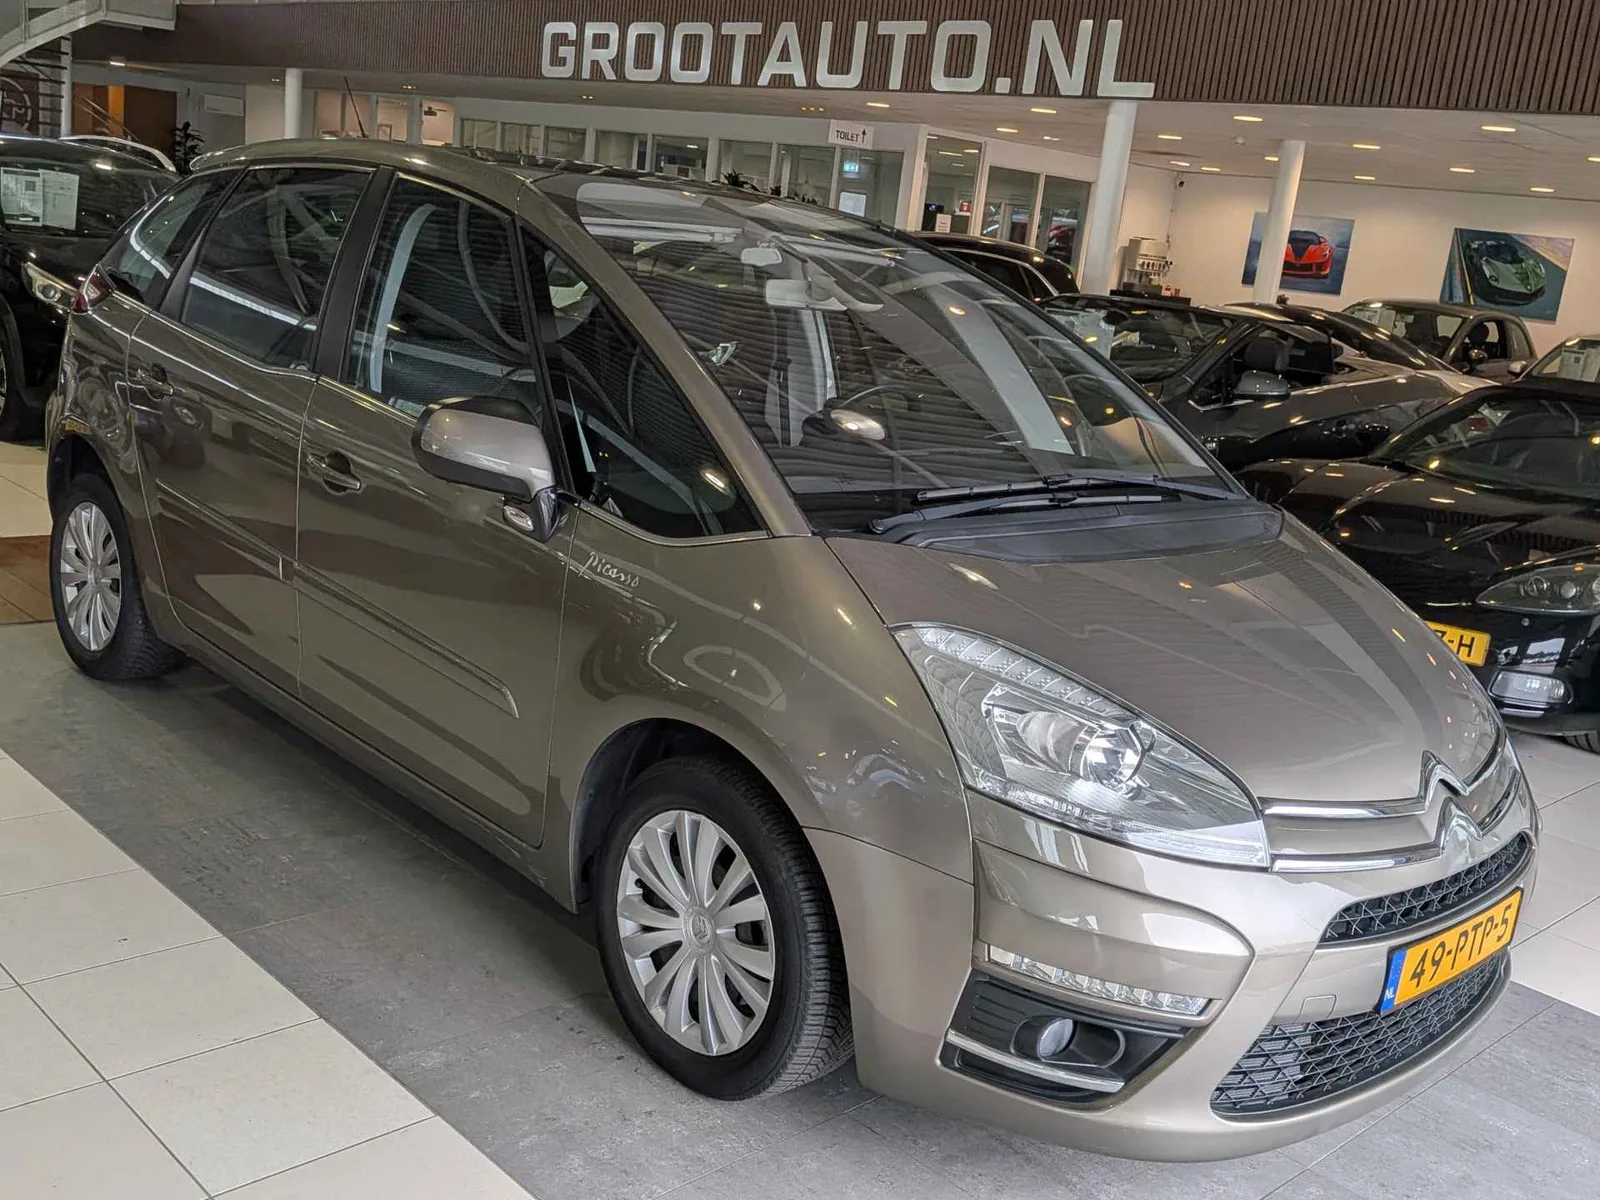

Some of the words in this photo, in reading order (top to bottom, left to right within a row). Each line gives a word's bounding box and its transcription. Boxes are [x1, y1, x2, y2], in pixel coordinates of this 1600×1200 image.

[541, 19, 1155, 98] GROOTAUTO.NL
[835, 129, 860, 142] TOILET
[1409, 903, 1512, 988] 49-PTP-5
[1384, 988, 1394, 999] NL
